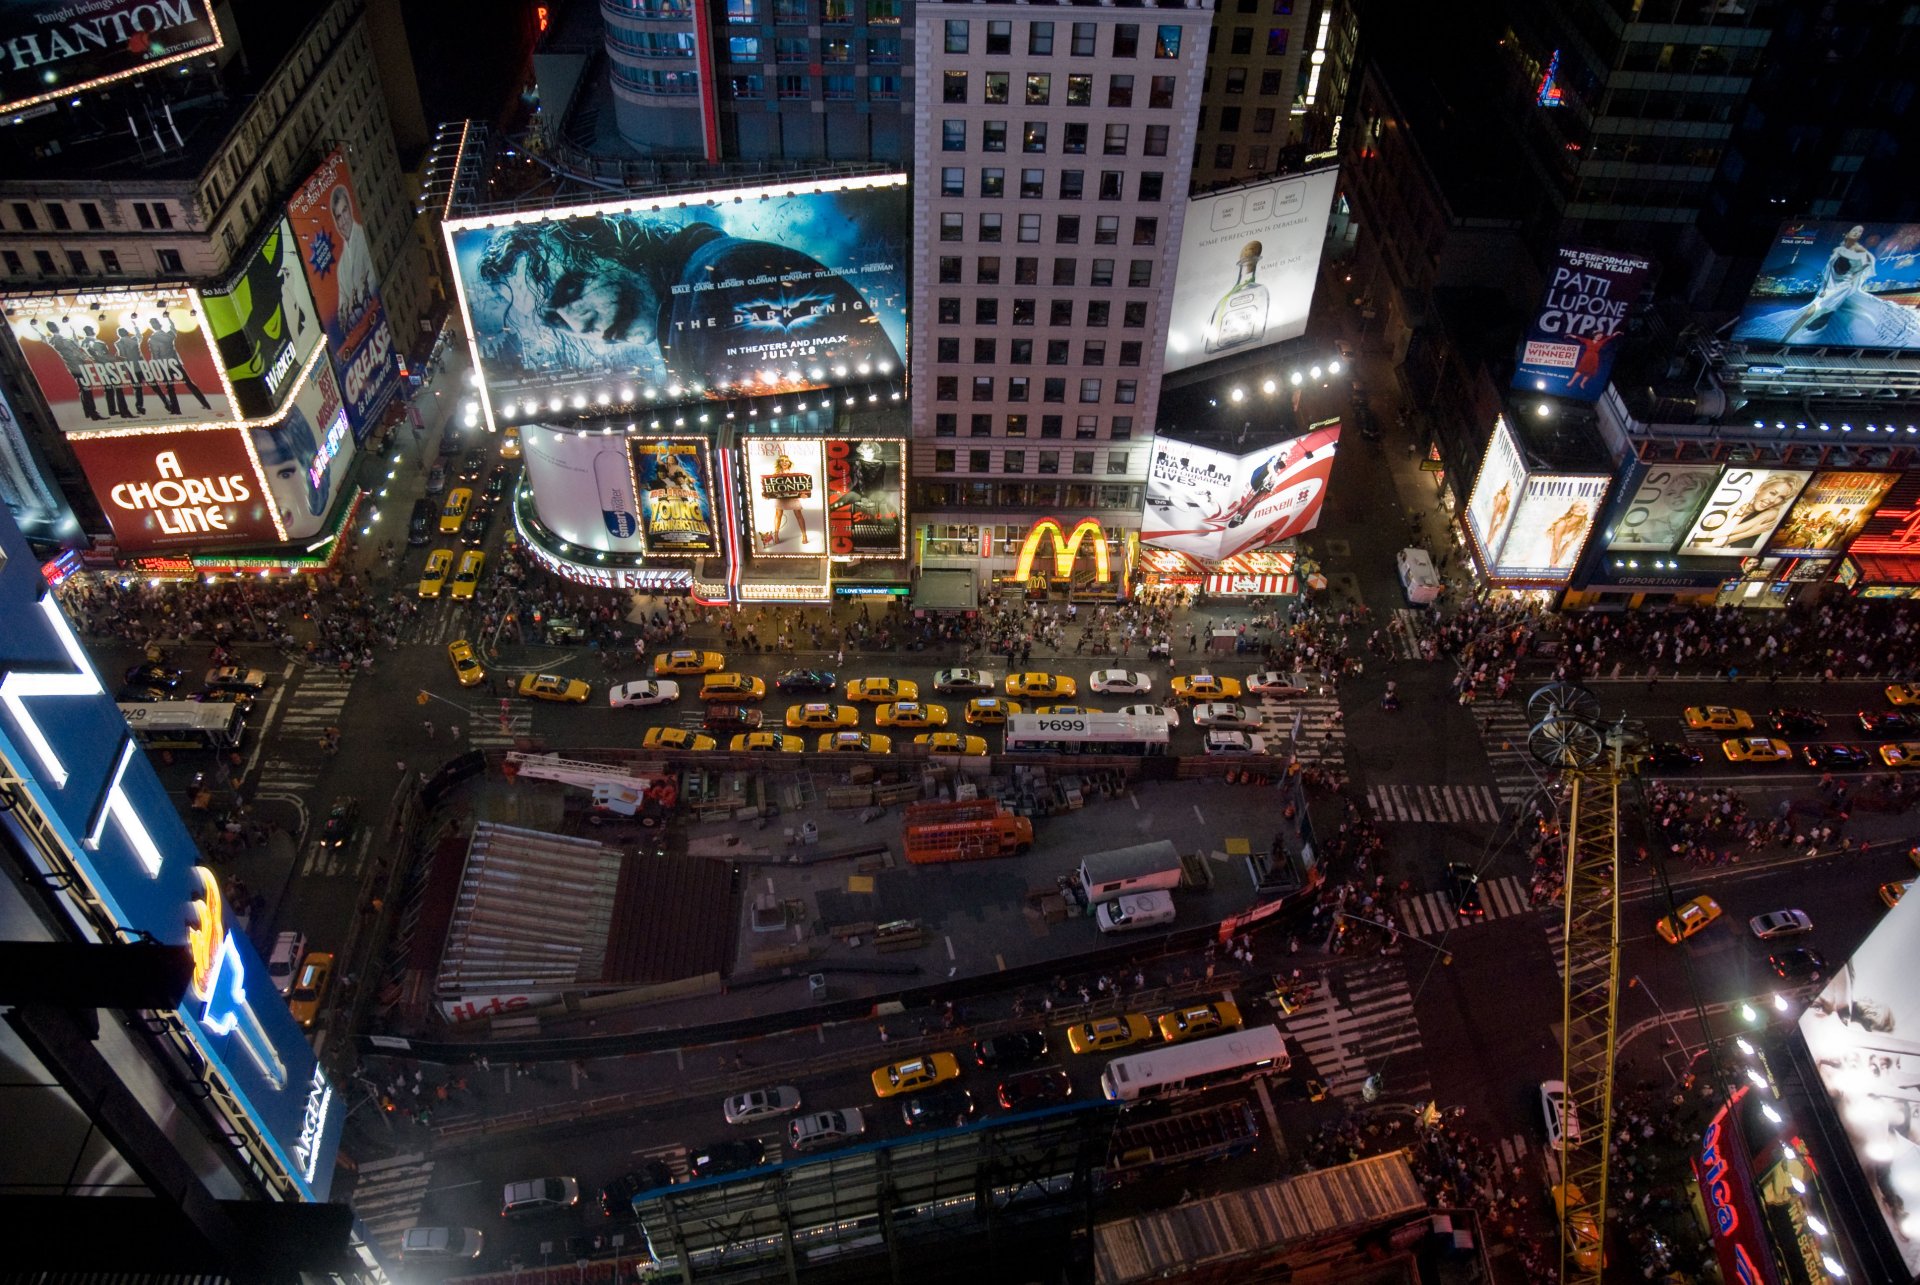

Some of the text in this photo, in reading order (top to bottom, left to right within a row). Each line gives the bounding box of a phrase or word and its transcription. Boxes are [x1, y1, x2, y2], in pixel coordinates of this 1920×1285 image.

[35, 7, 76, 24] Tonight
[76, 0, 115, 16] belongs
[1220, 227, 1264, 243] PERFECTION
[1559, 249, 1649, 270] THE PERFORMANCE
[1569, 258, 1634, 274] OF THE YEAR!
[717, 279, 745, 289] LEDGER
[747, 275, 777, 285] OLDMAN
[780, 272, 812, 282] ECKHART
[815, 267, 858, 278] GYLLENHAAL
[861, 264, 894, 273] FREEMAN
[1553, 267, 1611, 297] PATTI
[675, 296, 897, 331] THE DARK KNIGHT
[1538, 310, 1622, 336] GYPSY
[727, 334, 849, 356] IN THEATERS AND IMAX
[761, 345, 816, 361] JULY 18
[1528, 348, 1576, 360] WINNER!
[1529, 342, 1550, 350] TONY
[79, 357, 184, 387] JERSEY BOYS
[345, 320, 392, 405] GREASE
[155, 451, 184, 478] A
[1156, 458, 1232, 483] MAXIMUM
[763, 475, 812, 486] LEGALLY
[765, 483, 812, 494] BLONDE
[1153, 469, 1196, 487] LIVES
[1528, 481, 1574, 497] MAMMA
[110, 475, 251, 510] CHORUS
[827, 441, 854, 554] CHICAGO
[1834, 495, 1869, 505] MUSICAL
[611, 488, 630, 539] smartwater
[649, 500, 704, 521] YOUNG
[1253, 497, 1294, 519] maxell
[1614, 471, 1671, 544] TOUS
[1687, 471, 1753, 548] TOUS
[154, 505, 229, 535] LINE
[745, 586, 781, 594] LEGALLY
[1618, 576, 1696, 585] OPPORTUNITY
[1038, 719, 1085, 731] 6694
[452, 996, 528, 1024] tkts
[293, 1060, 326, 1173] ARGENT
